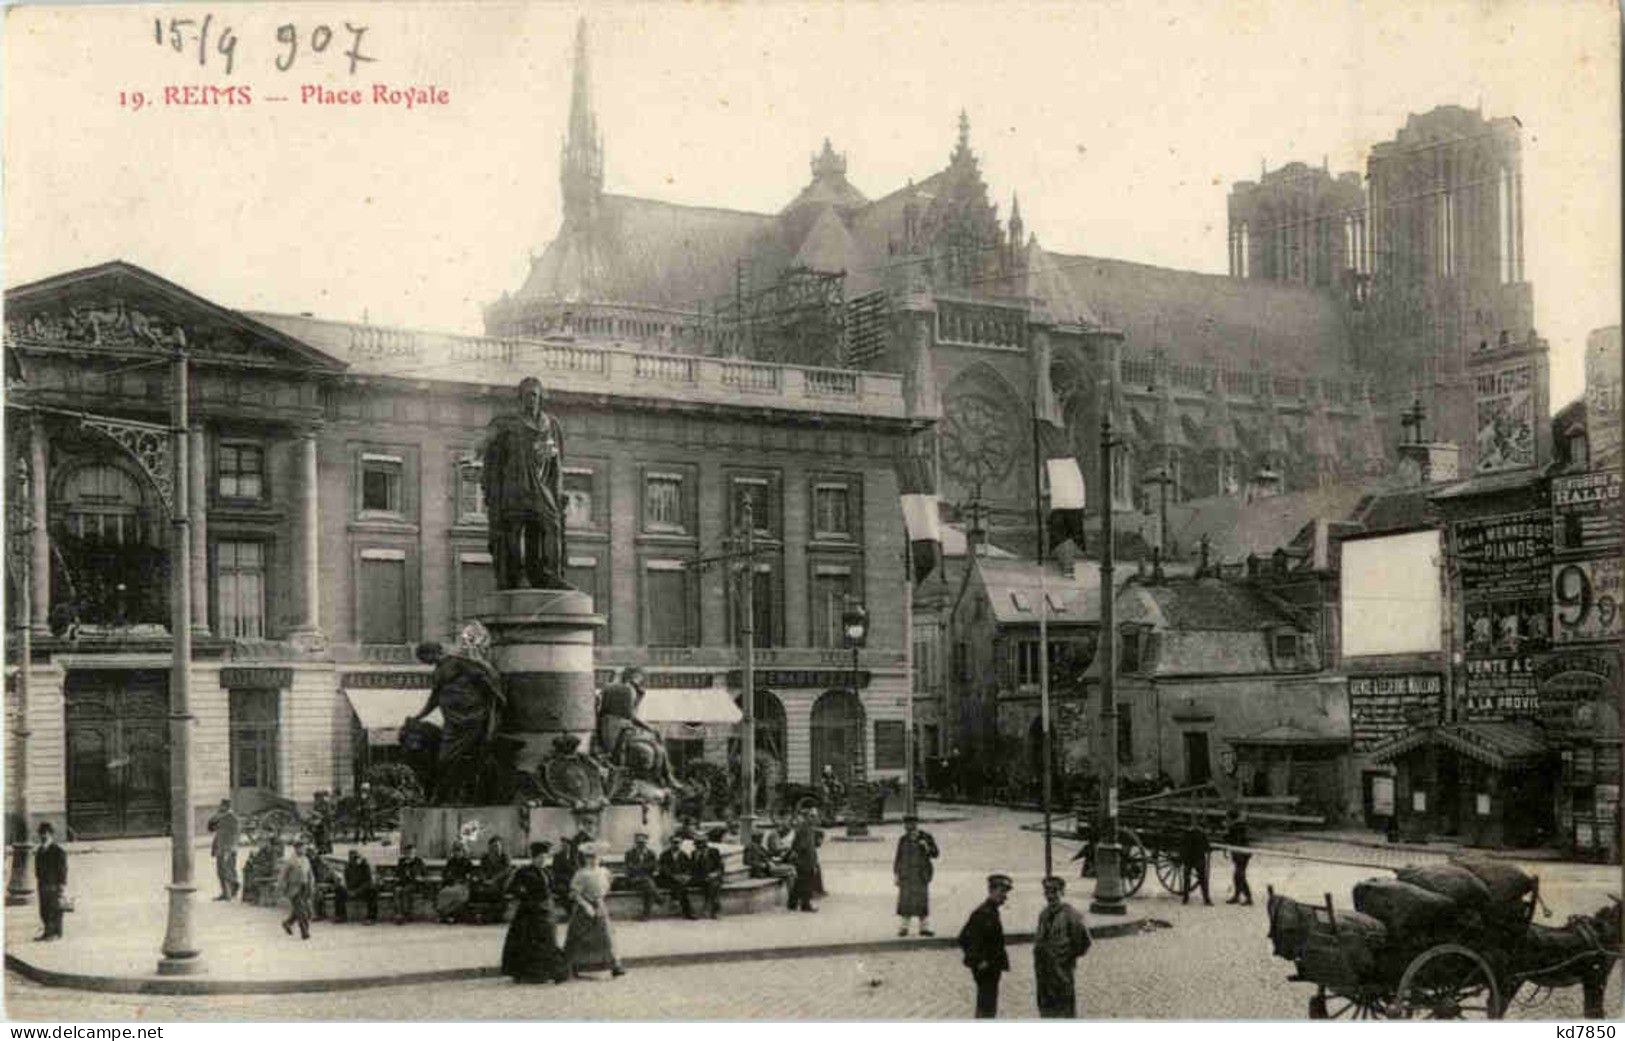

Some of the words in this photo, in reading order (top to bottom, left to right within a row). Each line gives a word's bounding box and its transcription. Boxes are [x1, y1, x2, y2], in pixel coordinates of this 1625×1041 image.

[1484, 539, 1536, 562] PIANOS
[1556, 565, 1595, 627] 9
[1478, 698, 1493, 710] LA
